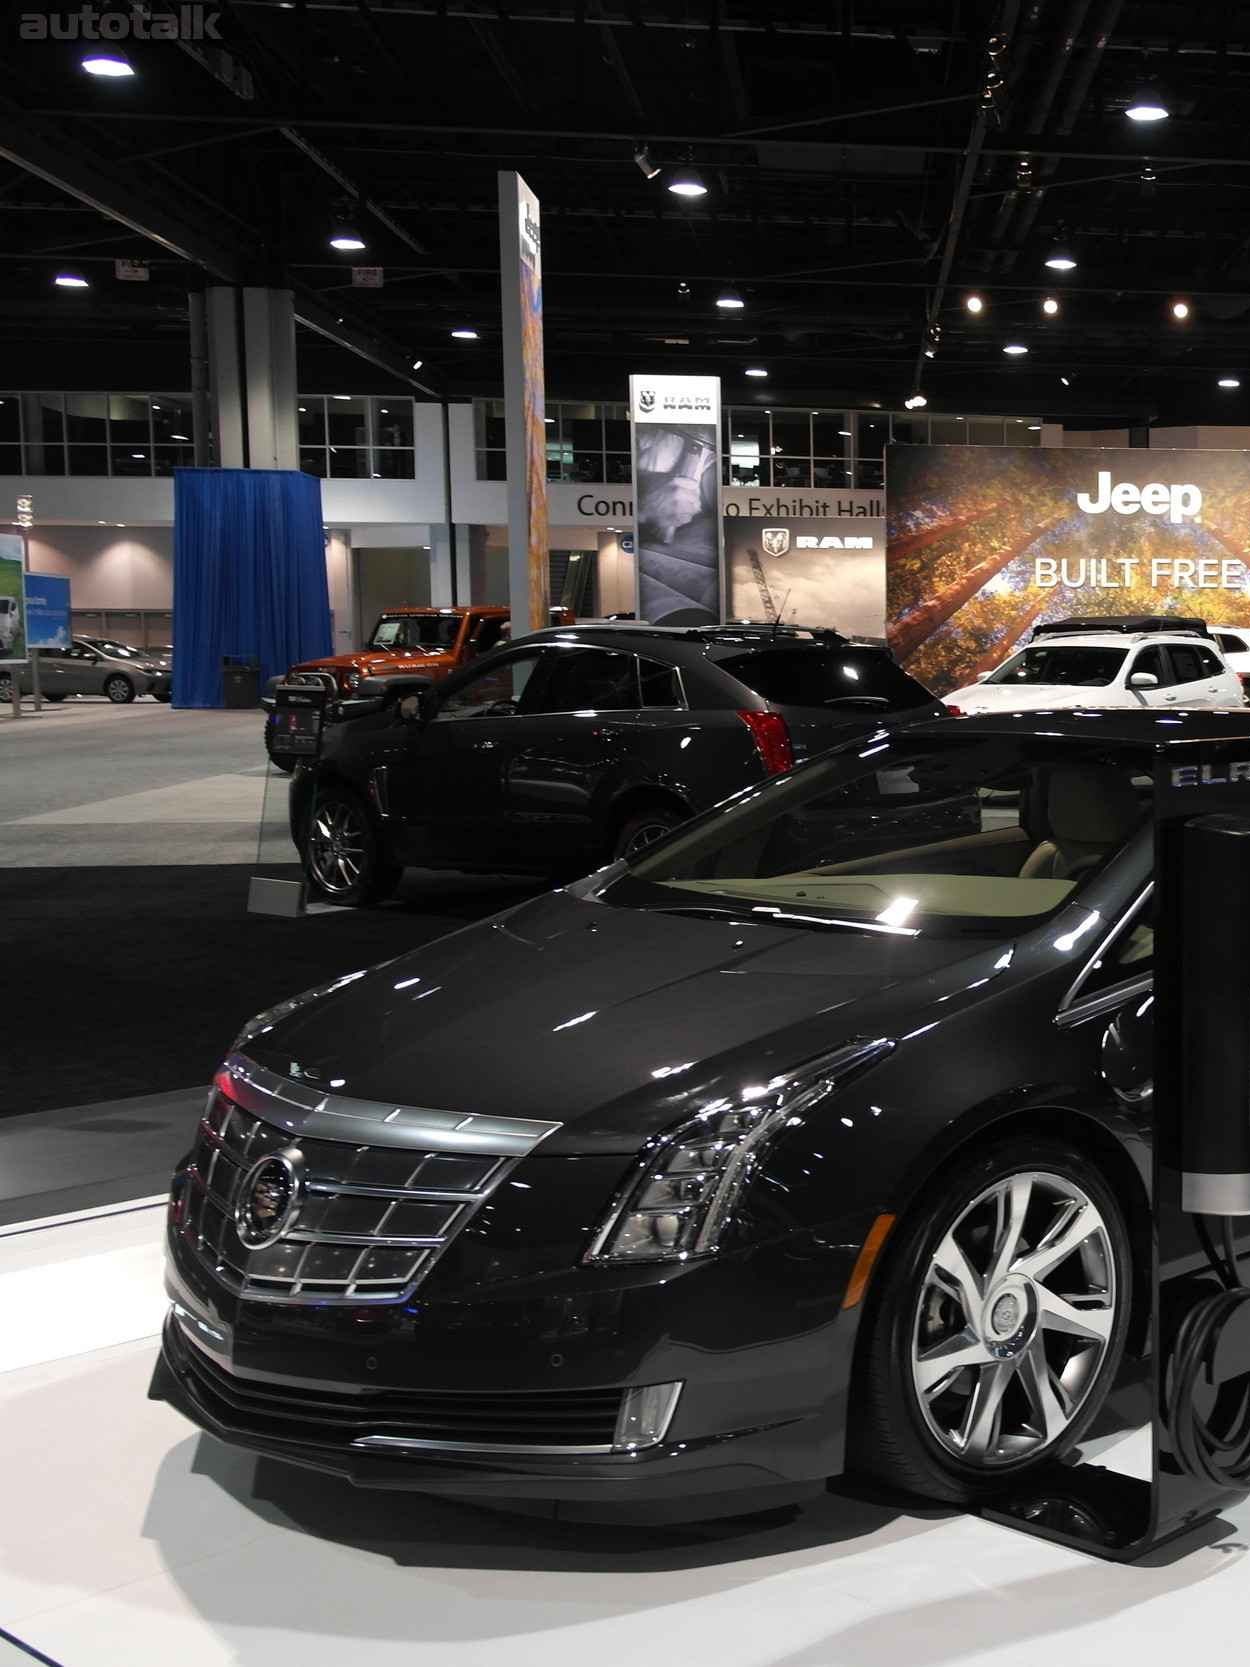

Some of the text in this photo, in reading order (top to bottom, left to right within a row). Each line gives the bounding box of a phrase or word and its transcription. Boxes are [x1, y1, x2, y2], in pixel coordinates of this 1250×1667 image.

[663, 396, 711, 411] RAM
[577, 494, 634, 517] Con
[837, 500, 884, 517] Hall
[1076, 471, 1203, 524] Jeep
[796, 536, 874, 549] RAM
[1034, 557, 1243, 589] BUILT FREE
